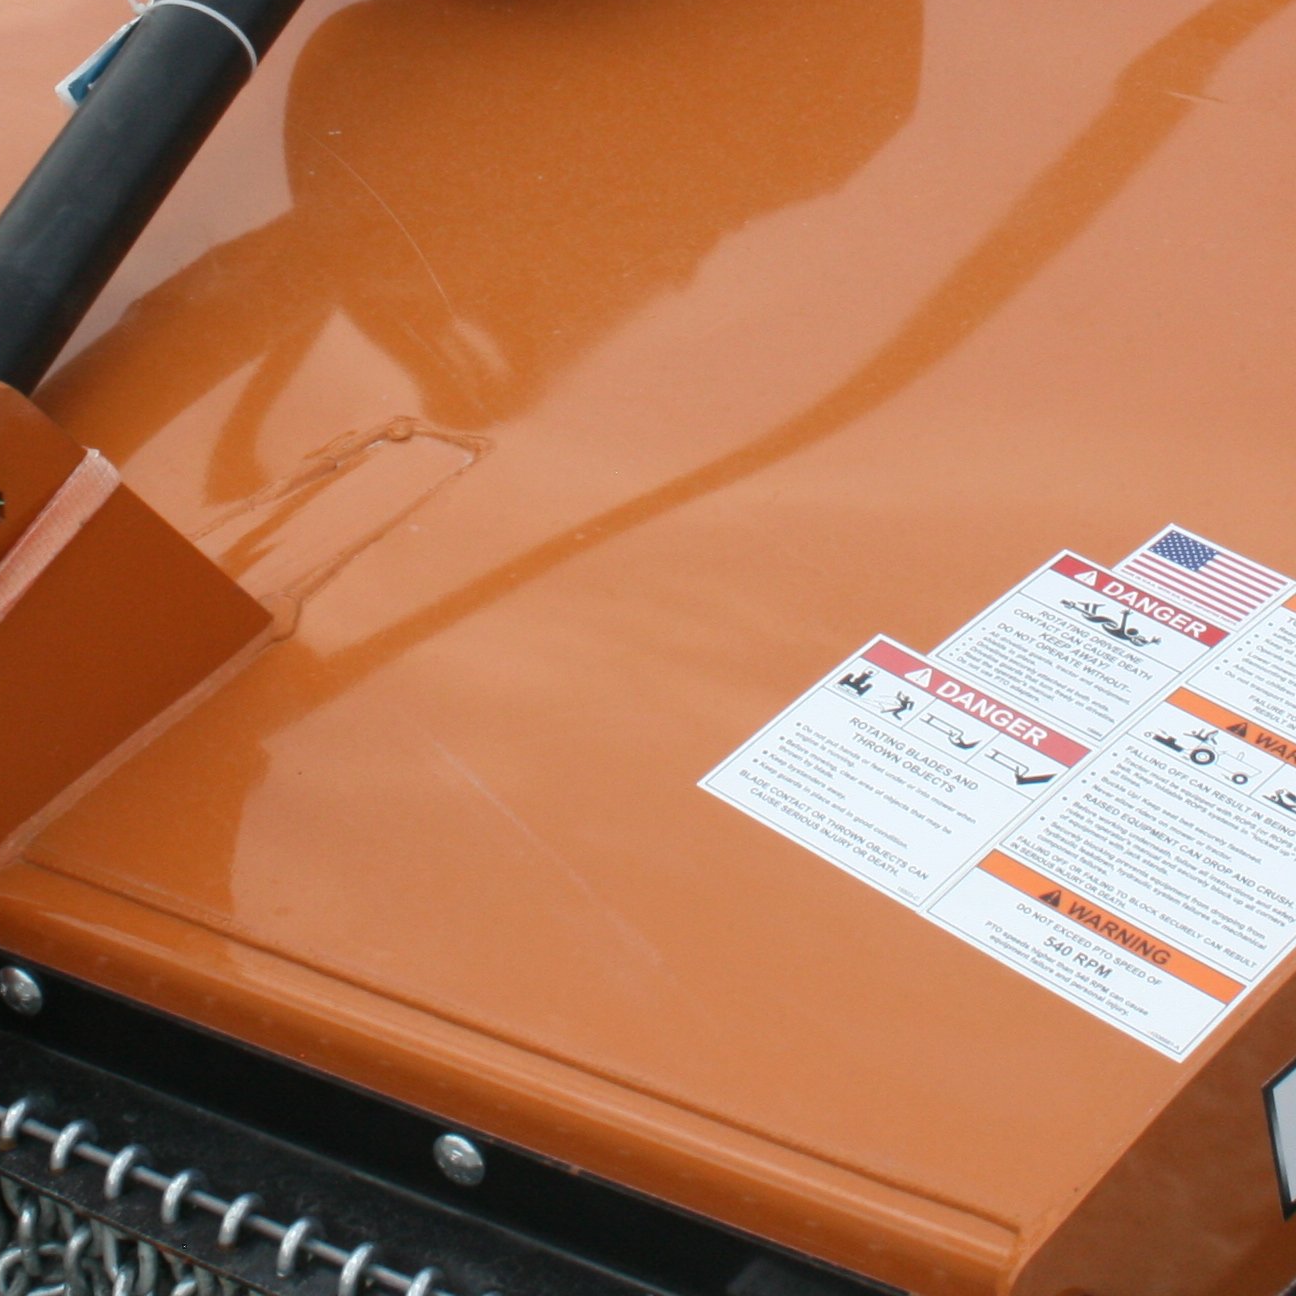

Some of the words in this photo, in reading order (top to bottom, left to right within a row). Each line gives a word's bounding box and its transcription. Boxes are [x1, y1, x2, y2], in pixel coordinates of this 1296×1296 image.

[1038, 610, 1091, 638] ROTATING
[1088, 635, 1143, 664] DRIVELINE
[1100, 580, 1209, 638] DANGER
[996, 622, 1015, 633] DO
[1012, 630, 1037, 644] NOT
[1033, 641, 1083, 668] OPERATE
[1012, 607, 1062, 634] CONTACT
[1058, 631, 1084, 645] CAN
[1080, 642, 1119, 663] CAUSE
[1116, 660, 1153, 680] DEATH
[1038, 631, 1072, 651] KEEP
[1069, 647, 1110, 670] AWAY!
[934, 680, 1050, 746] DANGER
[1247, 694, 1286, 715] FAILURE
[1251, 706, 1287, 725] RESULT
[848, 717, 907, 751] ROTATING
[903, 747, 954, 776] BLADES
[950, 773, 979, 791] AND
[850, 732, 903, 763] THROWN
[899, 760, 956, 793] OBJECTS
[1124, 745, 1169, 770] FALLING
[1165, 766, 1190, 781] OFF
[1187, 777, 1213, 793] CAN
[1209, 789, 1253, 814] RESULT
[1249, 810, 1265, 820] IN
[737, 769, 771, 789] BLADE
[767, 786, 813, 813] CONTACT
[808, 809, 828, 821] OR
[823, 818, 867, 844] THROWN
[863, 840, 909, 868] OBJECTS
[905, 865, 930, 880] CAN
[748, 786, 782, 808] CAUSE
[778, 804, 821, 830] SERIOUS
[817, 826, 854, 849] INJURY
[849, 845, 869, 858] OR
[1081, 792, 1122, 816] RAISED
[1118, 812, 1180, 847] EQUIPMENT
[1177, 843, 1204, 860] CAN
[1200, 856, 1234, 876] DROP
[1230, 872, 1257, 888] AND
[1008, 841, 1021, 850] IN
[1018, 846, 1056, 869] SERIOUS
[1053, 866, 1085, 885] INJURY
[1082, 882, 1099, 893] OR
[1015, 835, 1052, 856] FALLING
[1049, 853, 1070, 866] OFF
[1067, 863, 1084, 874] OR
[1081, 871, 1117, 892] FAILING
[1113, 888, 1130, 899] TO
[1126, 895, 1160, 916] BLOCK
[1157, 912, 1205, 940] SECURELY
[1201, 936, 1224, 951] CAN
[1221, 947, 1257, 969] RESULT
[1064, 901, 1174, 966] WARNING
[1015, 902, 1034, 915] DO
[1030, 911, 1055, 927] NOT
[1051, 922, 1094, 948] EXCEED
[1090, 944, 1115, 960] PTO
[1111, 956, 1148, 979] SPEED
[1144, 975, 1162, 987] OF
[1042, 935, 1076, 957] 540
[1070, 951, 1113, 978] RPM
